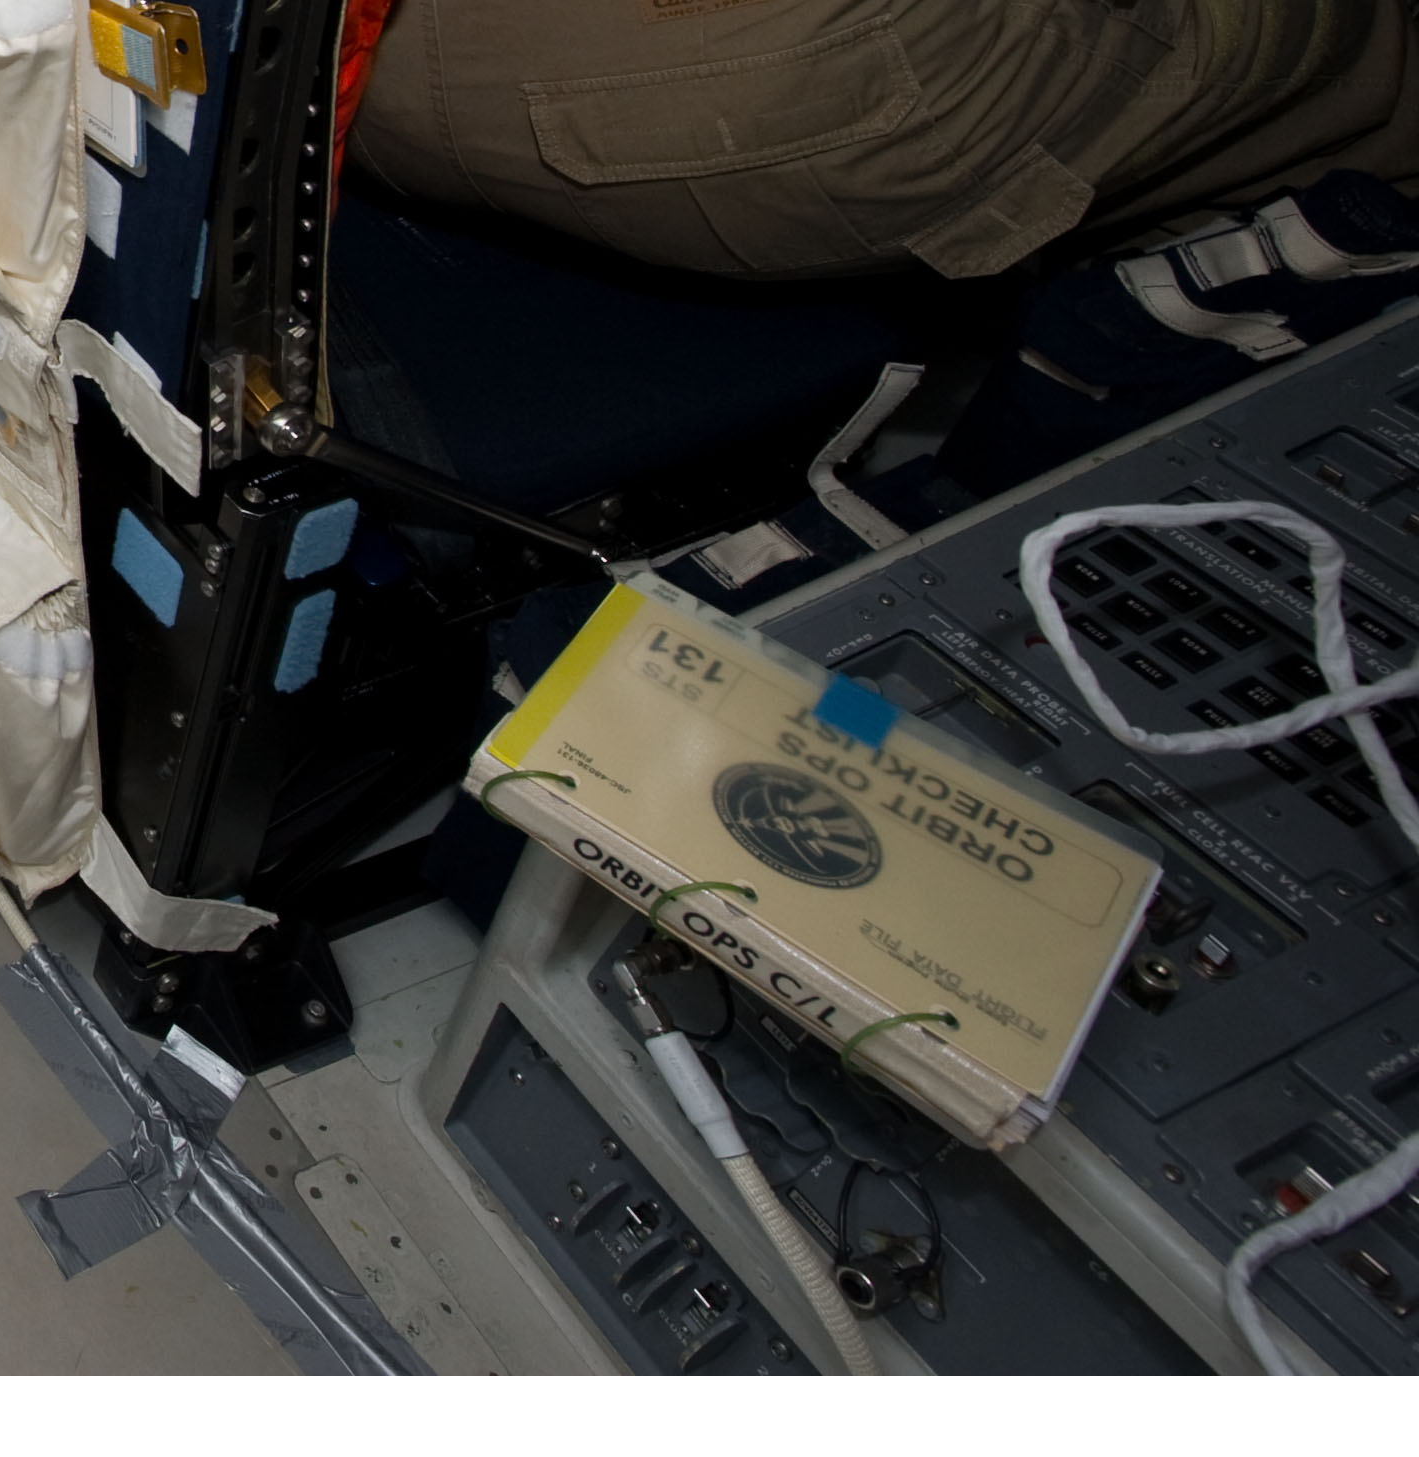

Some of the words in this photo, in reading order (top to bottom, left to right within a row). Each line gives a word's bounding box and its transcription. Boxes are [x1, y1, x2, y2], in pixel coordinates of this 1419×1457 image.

[1075, 563, 1100, 582] NORM
[1168, 528, 1261, 593] TRANSLATION
[648, 629, 725, 684] 131
[939, 629, 967, 651] LEFT
[1182, 637, 1208, 656] NORM
[641, 662, 703, 704] STS
[956, 627, 980, 648] AIR
[977, 640, 1015, 677] DATA
[1015, 676, 1069, 717] PROBE
[956, 651, 1033, 710] DEPLOY/HEAT
[1136, 659, 1162, 680] PULSE
[1032, 698, 1070, 728] RIGHT
[563, 740, 593, 763] FINAL
[776, 731, 871, 793] OPS
[882, 792, 1034, 883] ORBIT
[1153, 778, 1187, 804] FUEL
[1193, 807, 1227, 835] CELL
[1231, 838, 1274, 874] REAC
[1277, 873, 1314, 902] VLV
[1187, 826, 1231, 864] CLOSE
[683, 912, 760, 970] OPS
[771, 972, 836, 1028] C/L
[912, 950, 967, 993] DATA
[971, 987, 1047, 1042] FLIGHT
